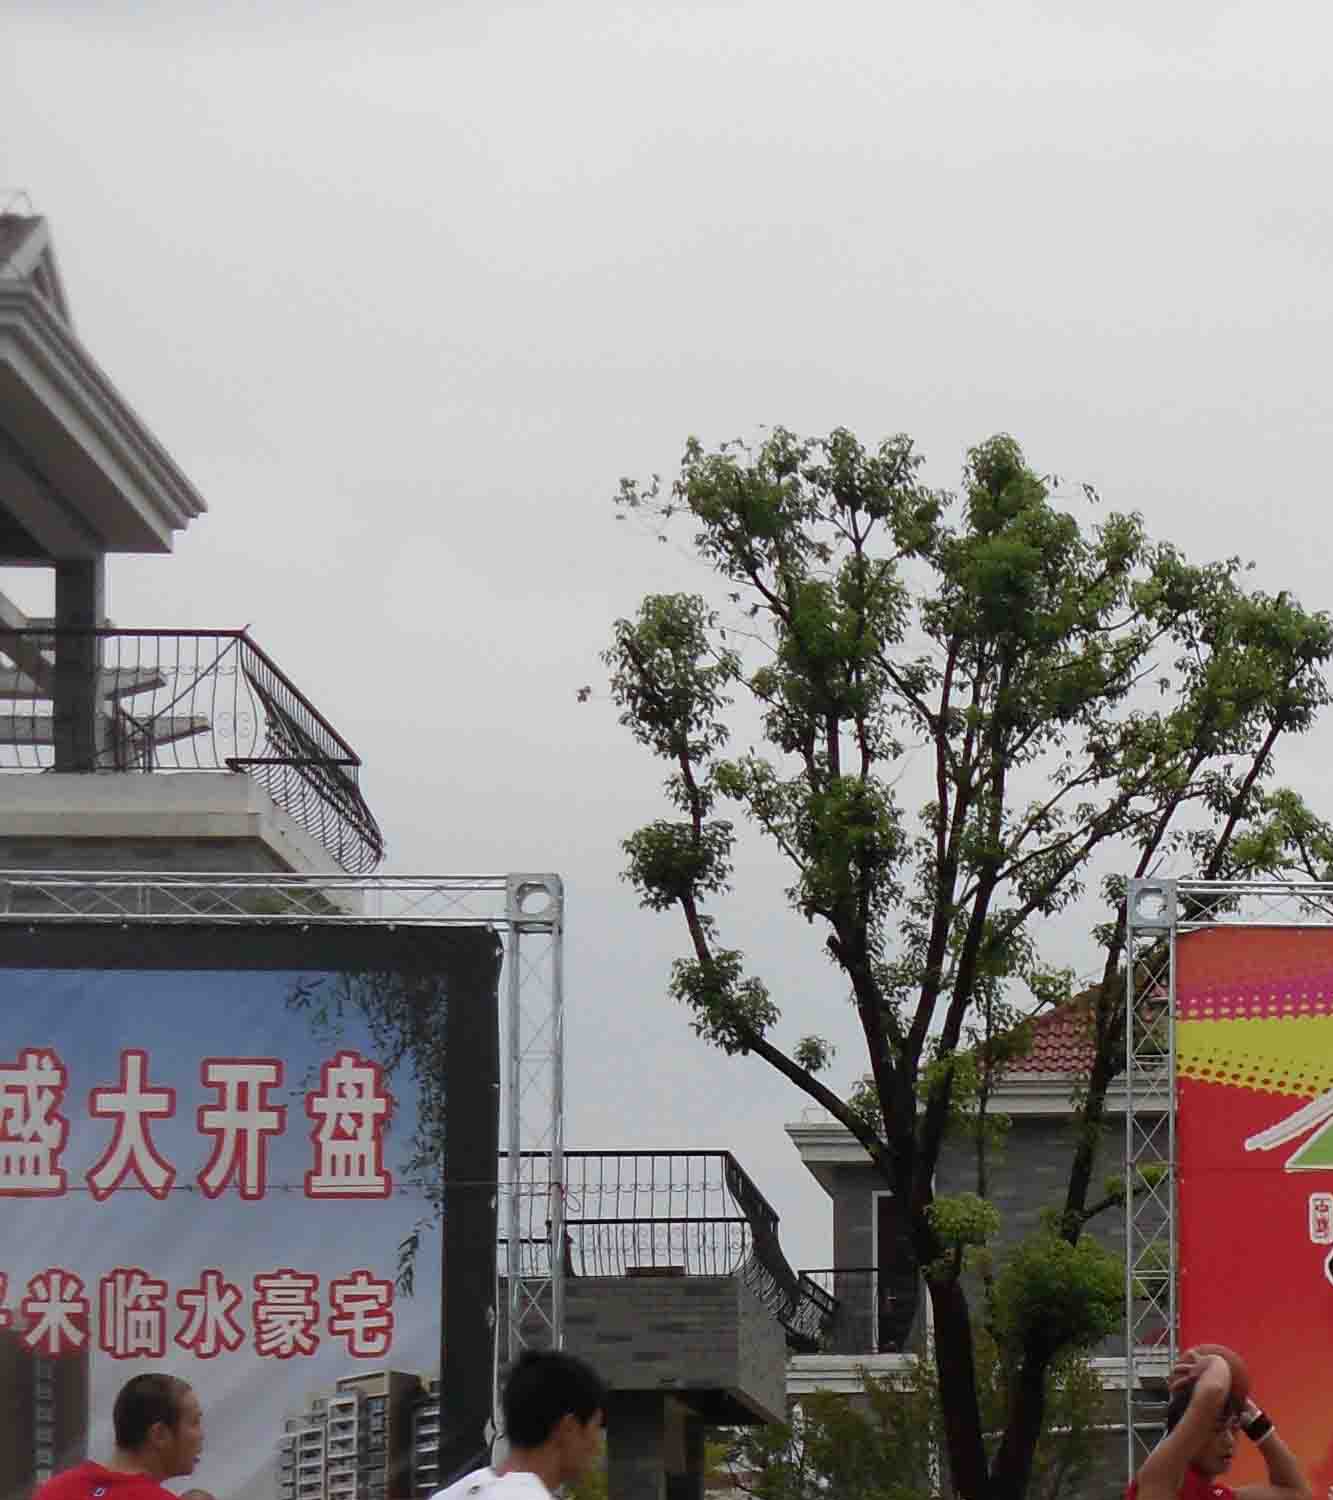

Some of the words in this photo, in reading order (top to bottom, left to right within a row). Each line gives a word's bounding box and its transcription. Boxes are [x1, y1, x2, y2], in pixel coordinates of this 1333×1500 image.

[0, 1048, 392, 1200] 盛大开盘
[0, 1269, 394, 1360] 米临水豪宅
